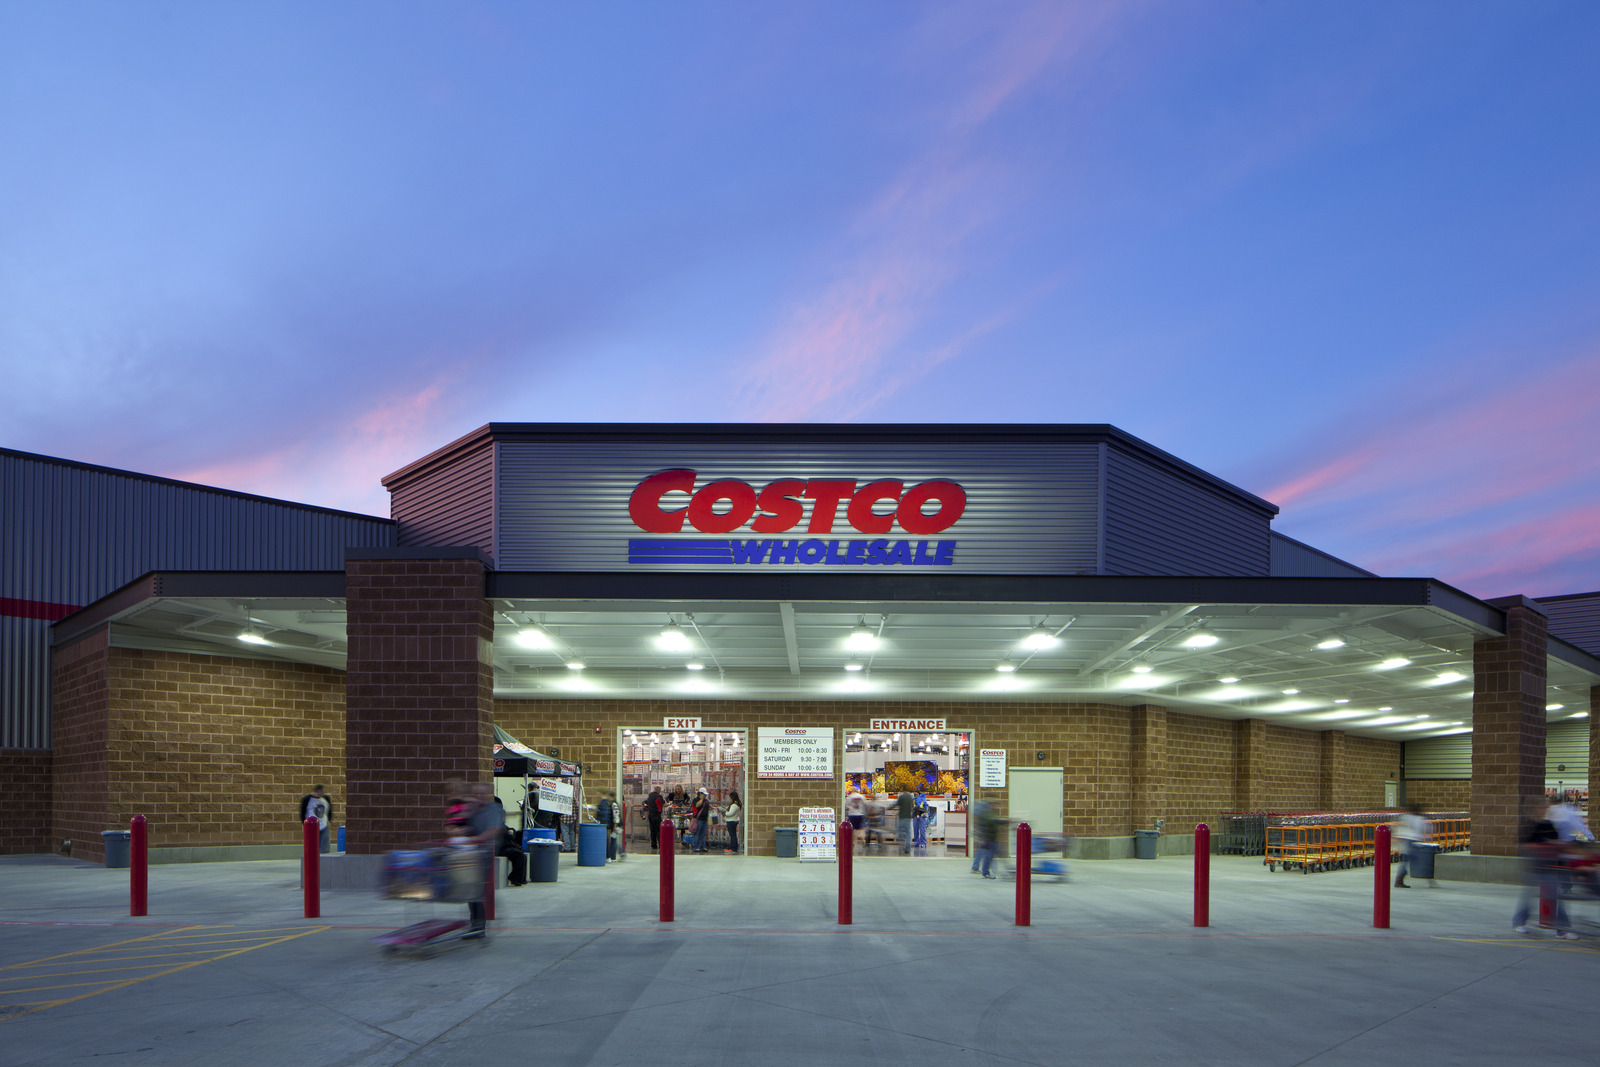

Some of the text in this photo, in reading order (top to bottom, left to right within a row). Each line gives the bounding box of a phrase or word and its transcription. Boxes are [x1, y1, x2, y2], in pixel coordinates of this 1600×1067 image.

[628, 468, 967, 535] COSTCO
[730, 539, 957, 566] WHOLESALE
[668, 719, 698, 728] EXIT
[872, 720, 944, 730] ENTRANCE
[542, 779, 556, 789] COSTCO
